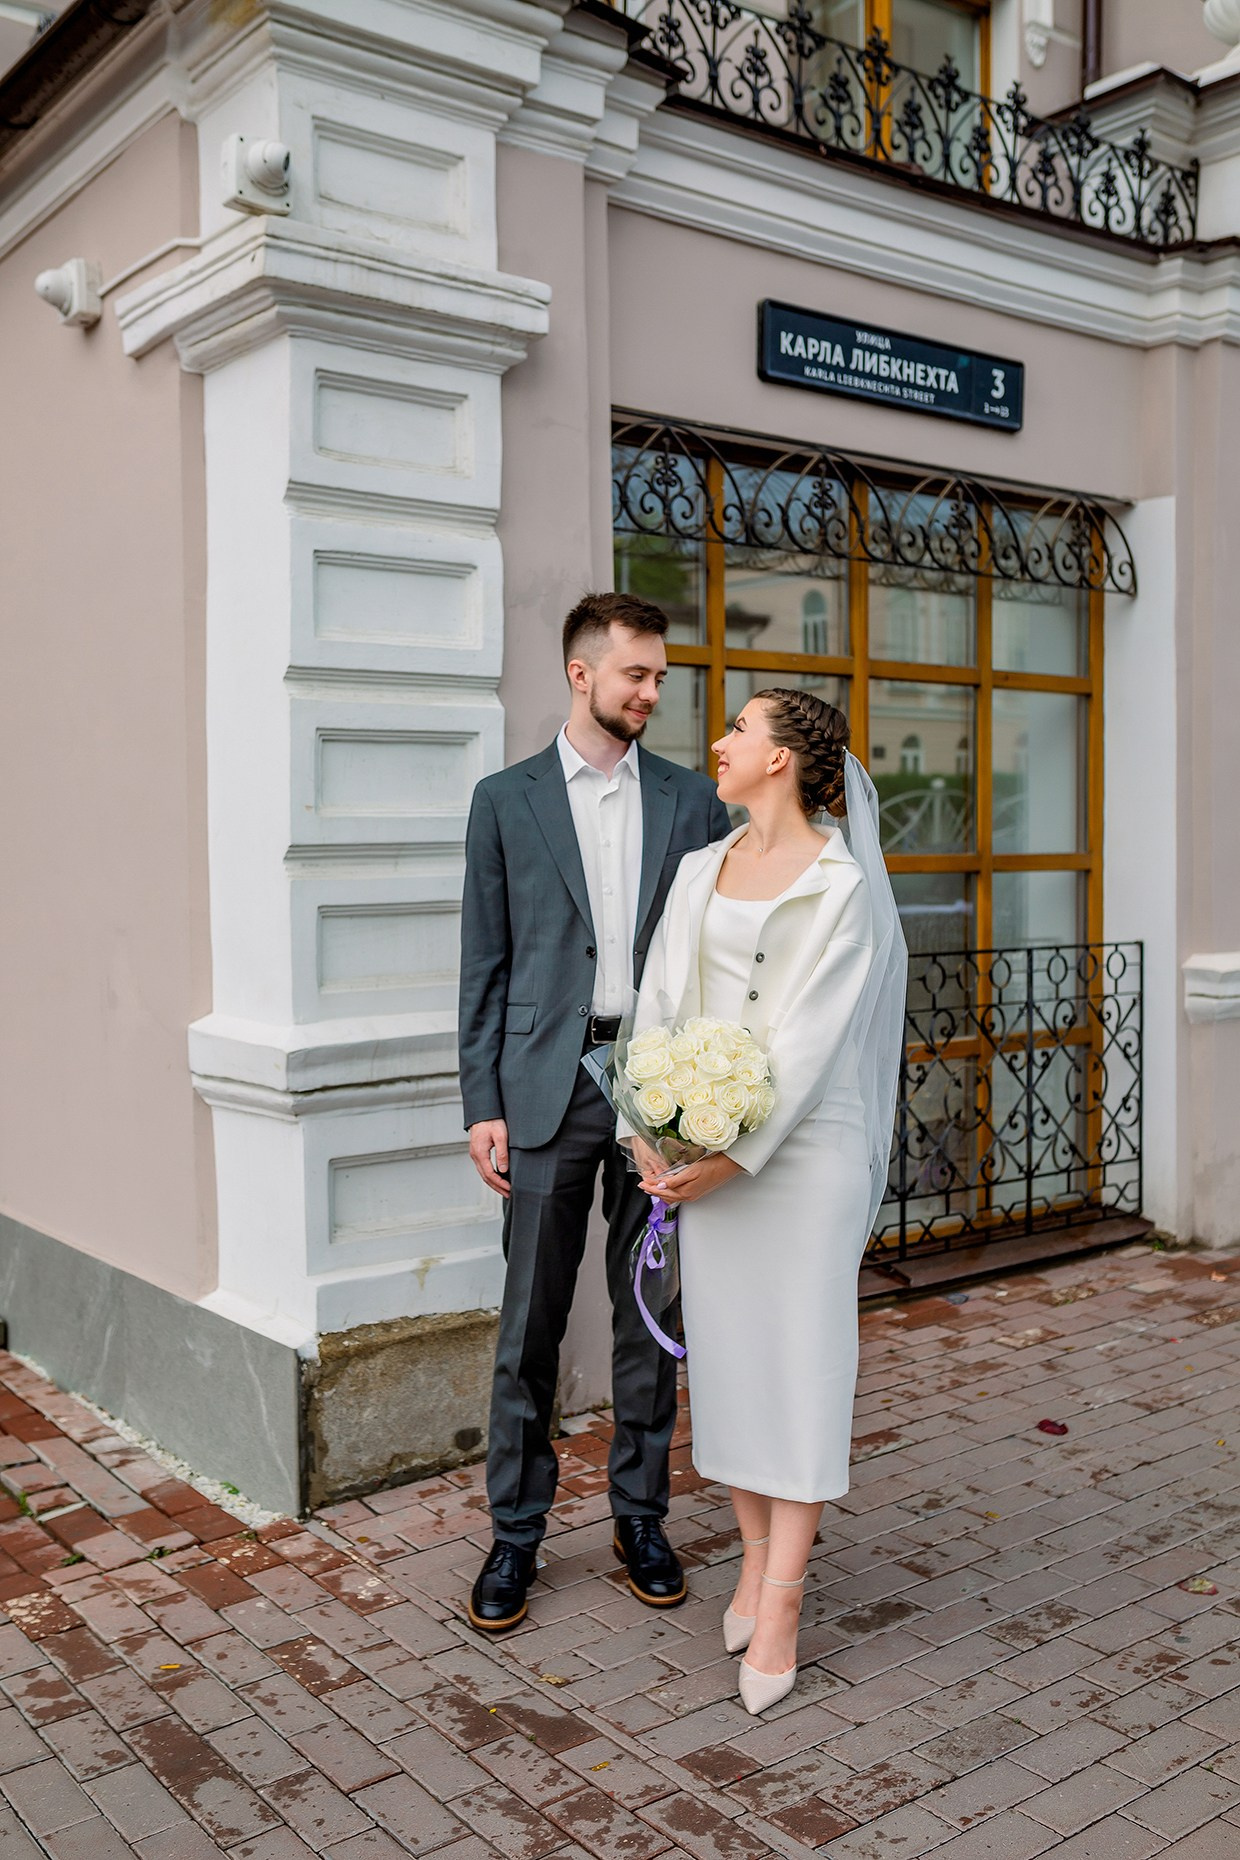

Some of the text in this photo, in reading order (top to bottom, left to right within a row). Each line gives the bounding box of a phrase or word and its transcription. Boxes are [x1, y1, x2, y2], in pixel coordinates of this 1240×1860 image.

[855, 330, 891, 350] УЛИЦА
[780, 330, 959, 394] КАРЛА ЛИБКНЕХТА
[804, 365, 835, 382] KARLA
[902, 387, 935, 404] STREET
[990, 368, 1005, 399] 3
